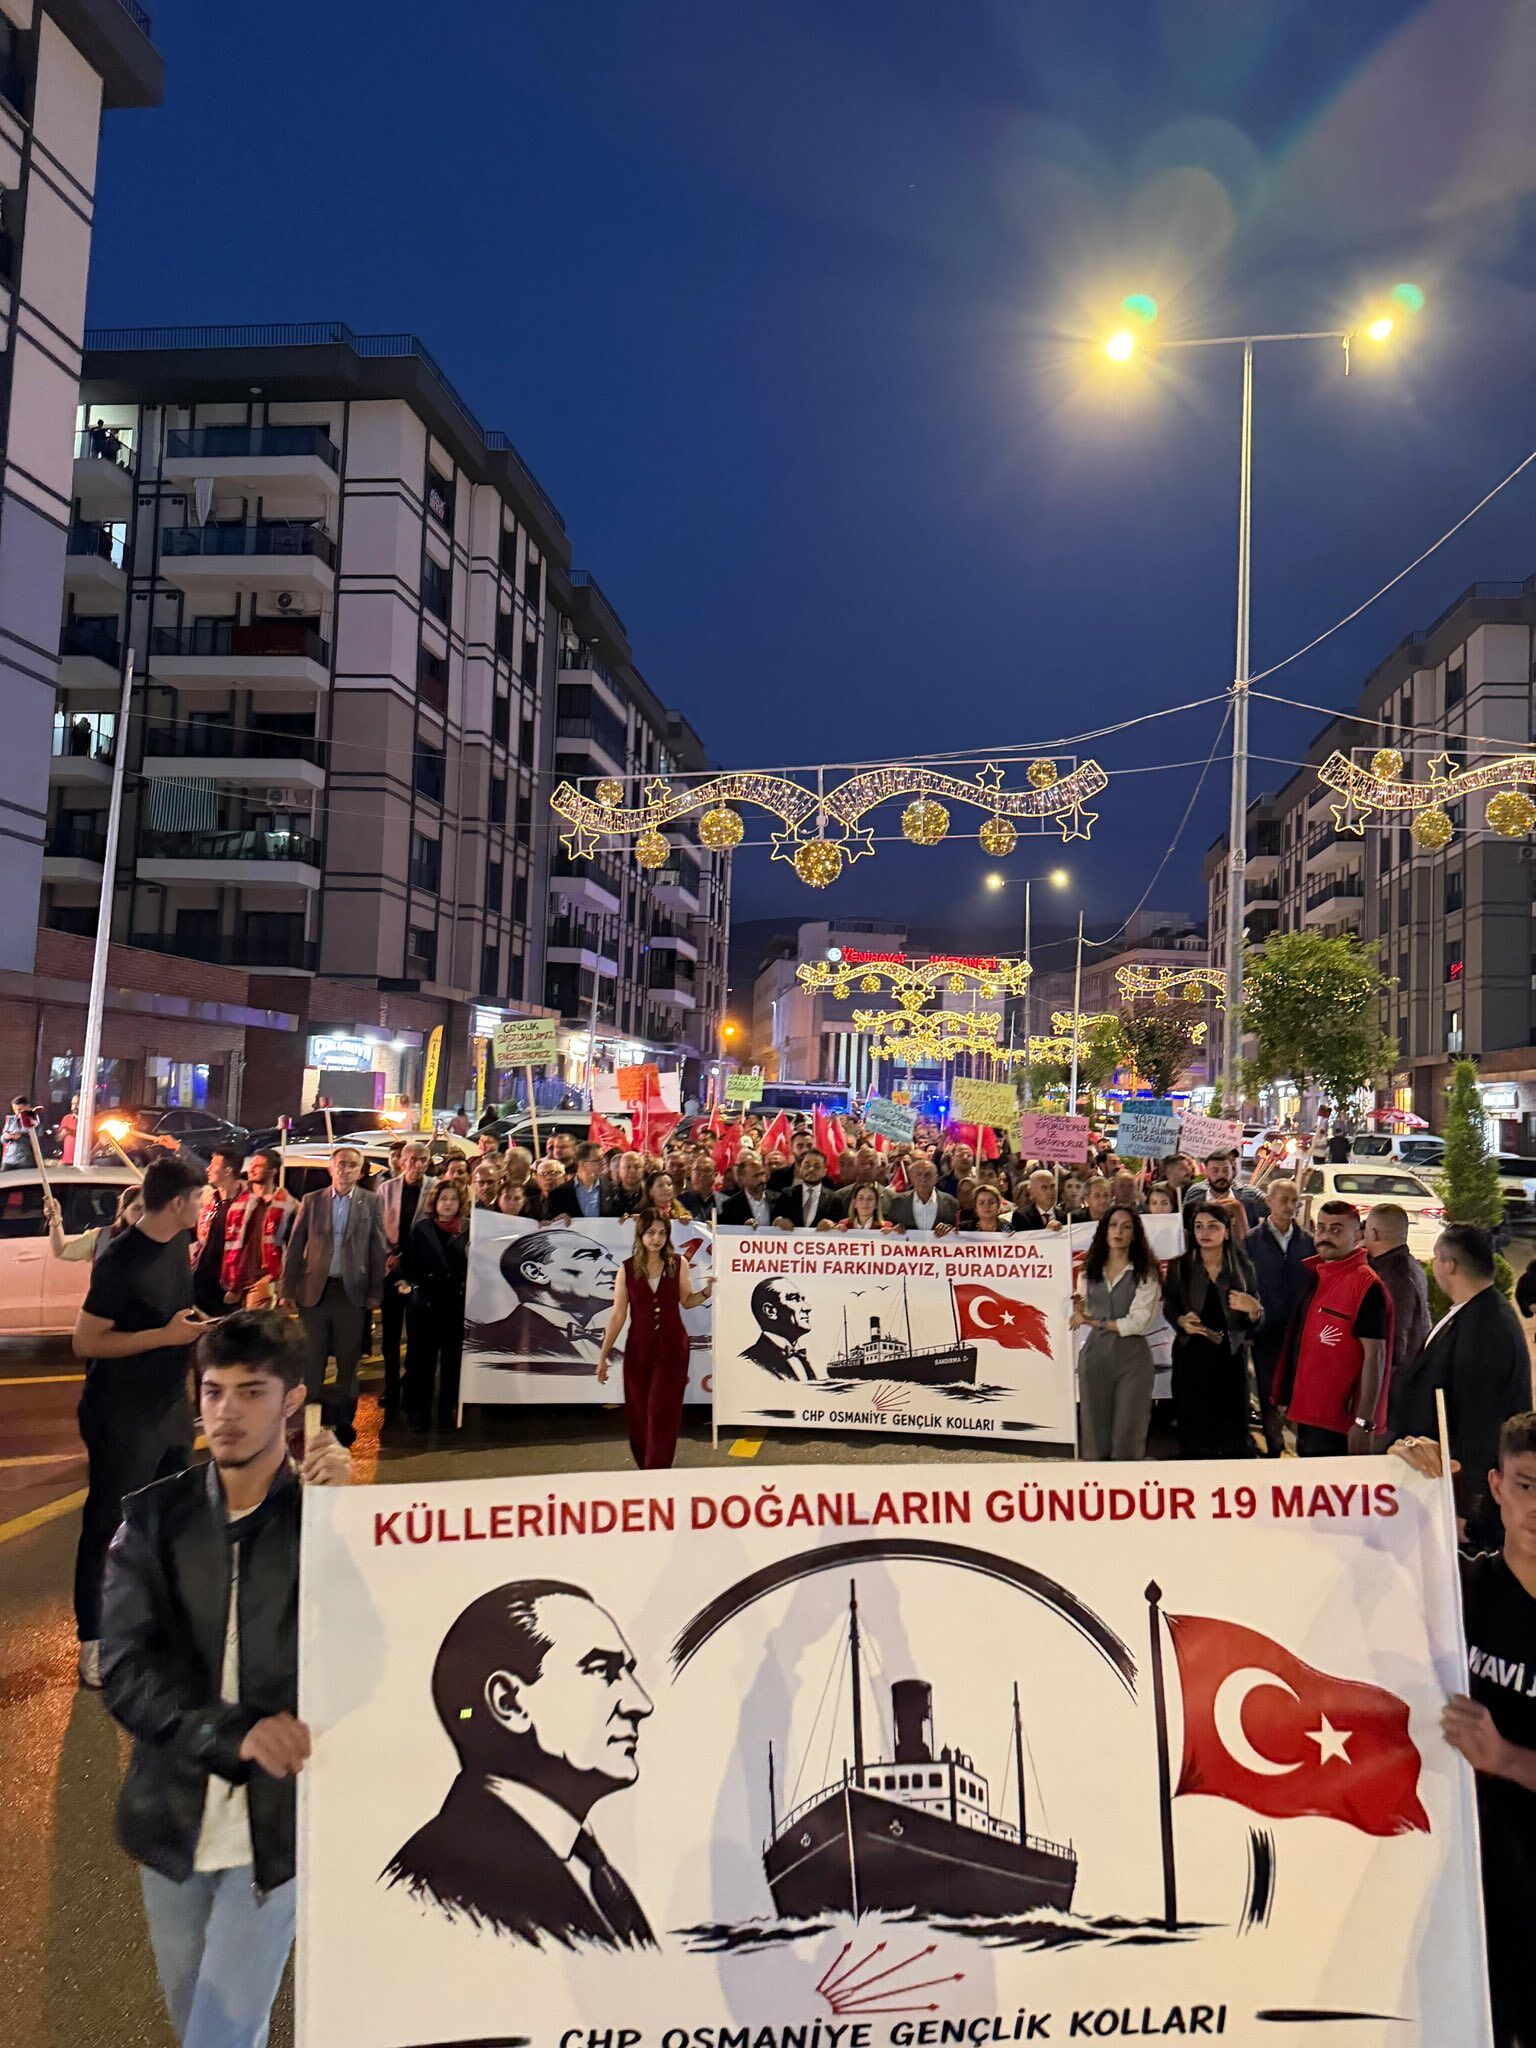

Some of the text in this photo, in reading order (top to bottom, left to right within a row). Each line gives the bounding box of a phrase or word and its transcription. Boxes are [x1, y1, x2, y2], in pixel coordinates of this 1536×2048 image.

[739, 1240, 1044, 1260] ONUN CESARETİ DAMARLARIMIZDA.
[731, 1257, 1053, 1280] EMANETİN FARKINDAYIZ, BURADAYIZ!
[802, 1409, 995, 1432] CHP OSMANİYE GENÇLİK KOLLARI
[374, 1481, 1399, 1547] KÜLLERİNDEN DOĞANLARIN GÜNÜDÜR 19 MAYIS
[560, 2005, 1228, 2048] CHP OSMANİYE GENÇLİK KOLLARI
